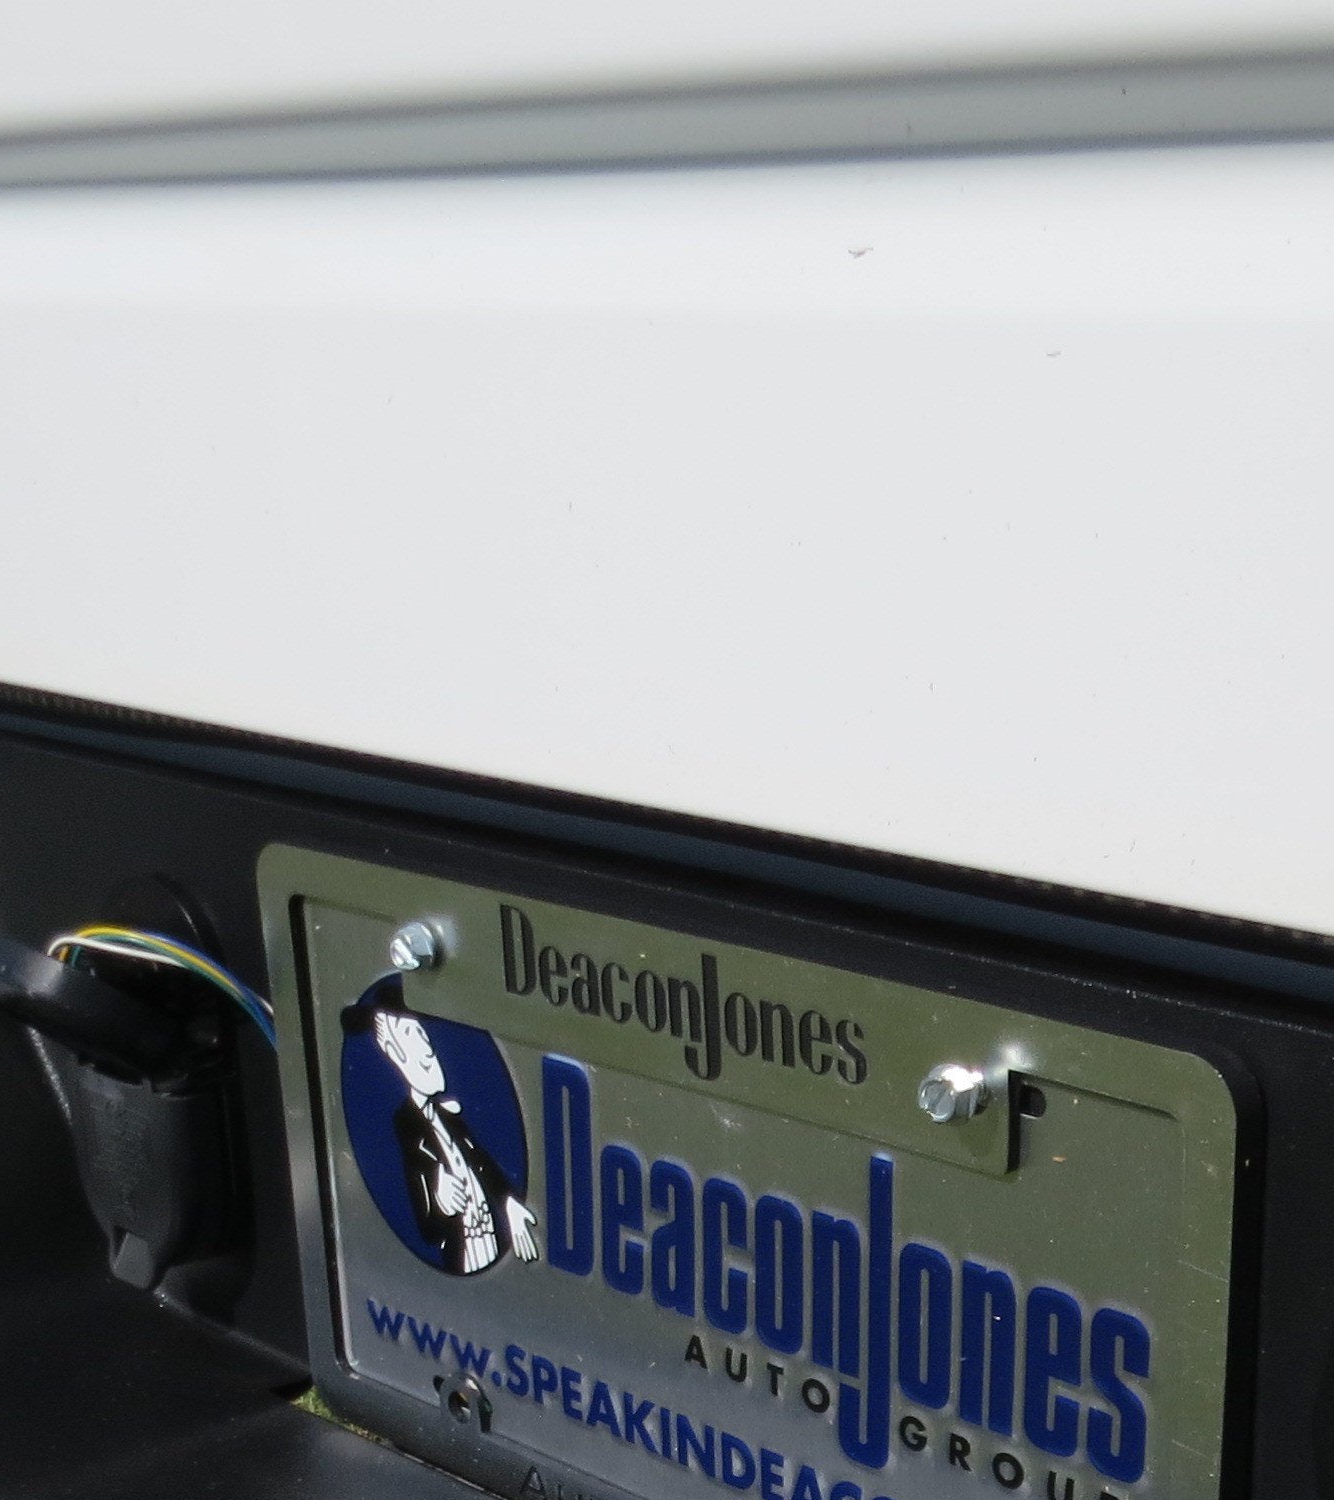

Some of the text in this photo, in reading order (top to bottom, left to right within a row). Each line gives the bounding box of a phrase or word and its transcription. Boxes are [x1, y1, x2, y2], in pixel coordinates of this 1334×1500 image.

[500, 904, 868, 1085] DeaconJones
[541, 1054, 1150, 1484] DeaconJones
[684, 1335, 831, 1413] AUTO
